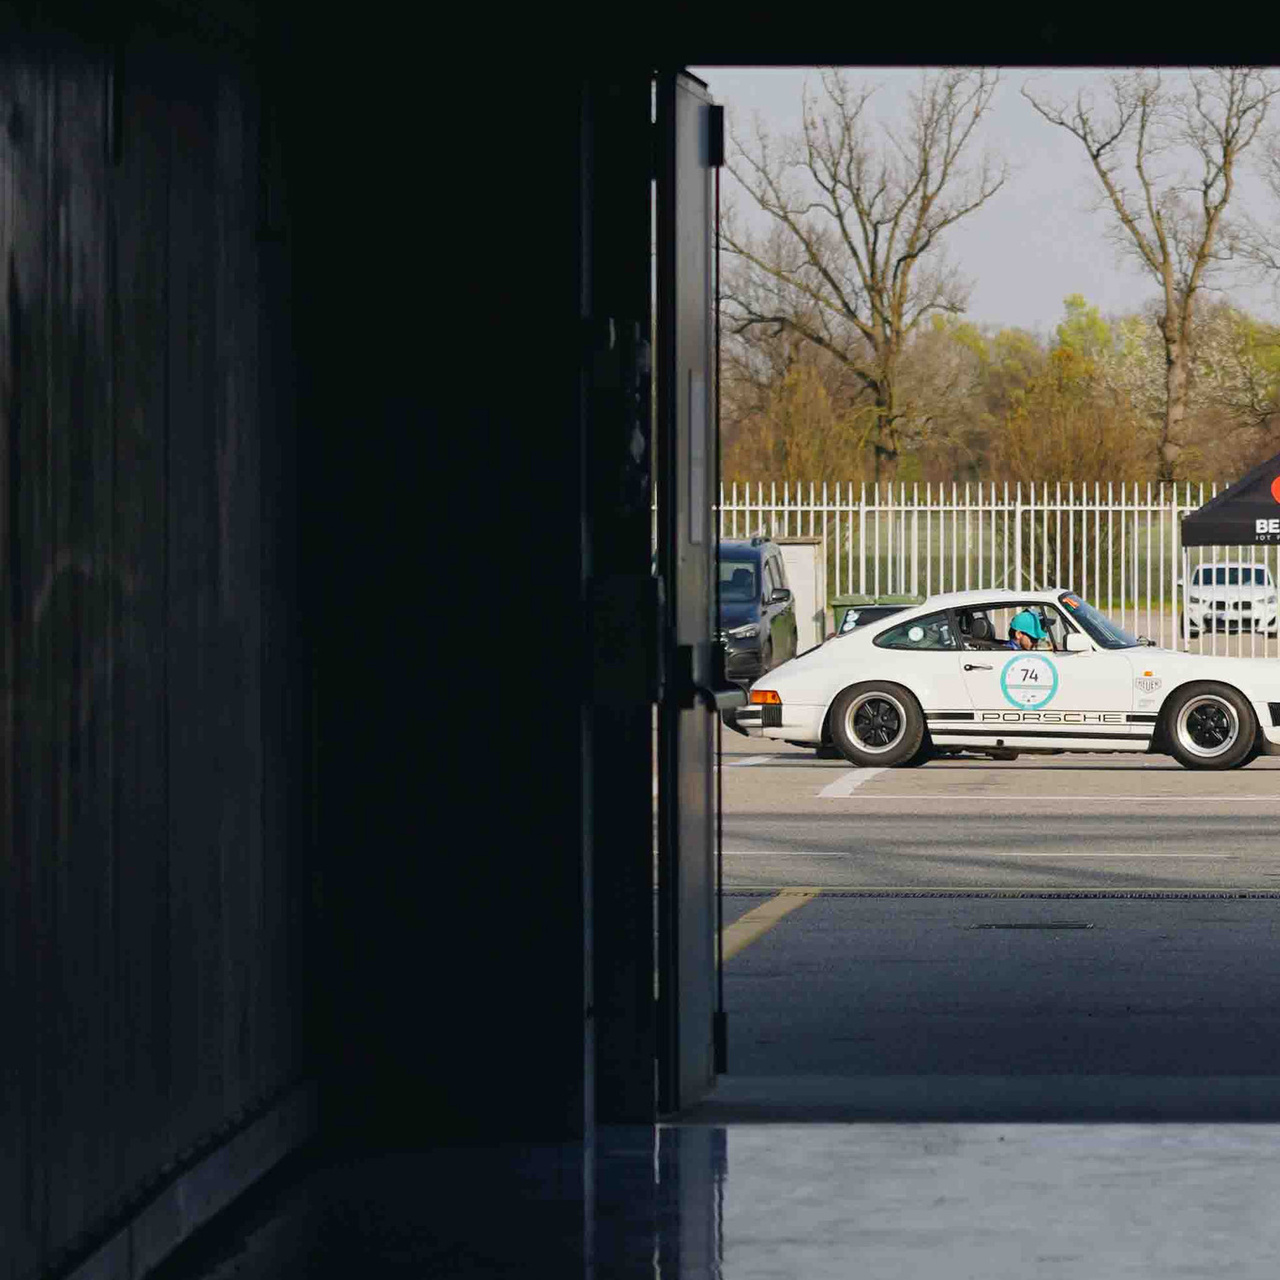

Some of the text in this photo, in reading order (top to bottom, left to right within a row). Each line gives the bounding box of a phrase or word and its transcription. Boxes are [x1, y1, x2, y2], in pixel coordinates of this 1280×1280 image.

[1255, 519, 1280, 534] BE
[1020, 668, 1038, 682] 74
[982, 712, 1122, 723] PORSCHE
